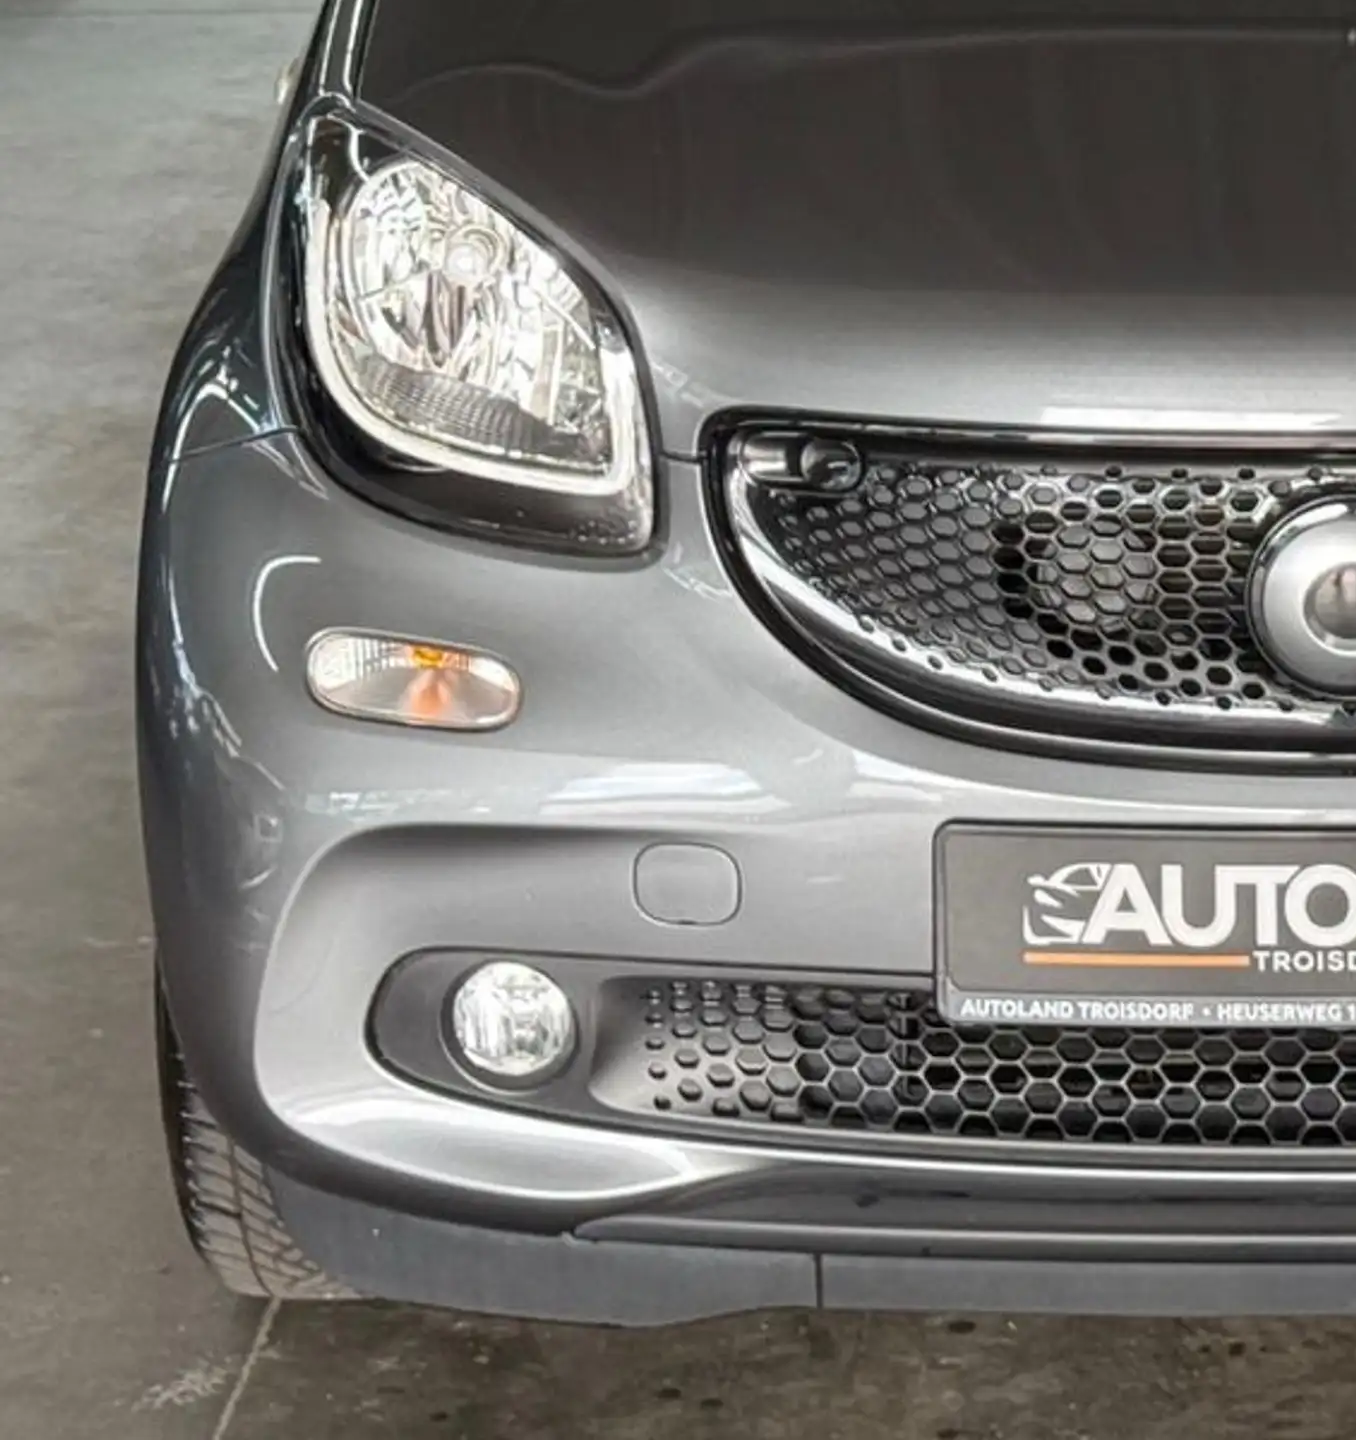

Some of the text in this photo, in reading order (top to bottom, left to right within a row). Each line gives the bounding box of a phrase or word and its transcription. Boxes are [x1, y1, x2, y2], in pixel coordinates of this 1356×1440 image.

[960, 998, 1075, 1019] AUTOLAND
[1077, 1000, 1194, 1021] TROISDORF
[1217, 1002, 1346, 1022] HEUSERWEG
